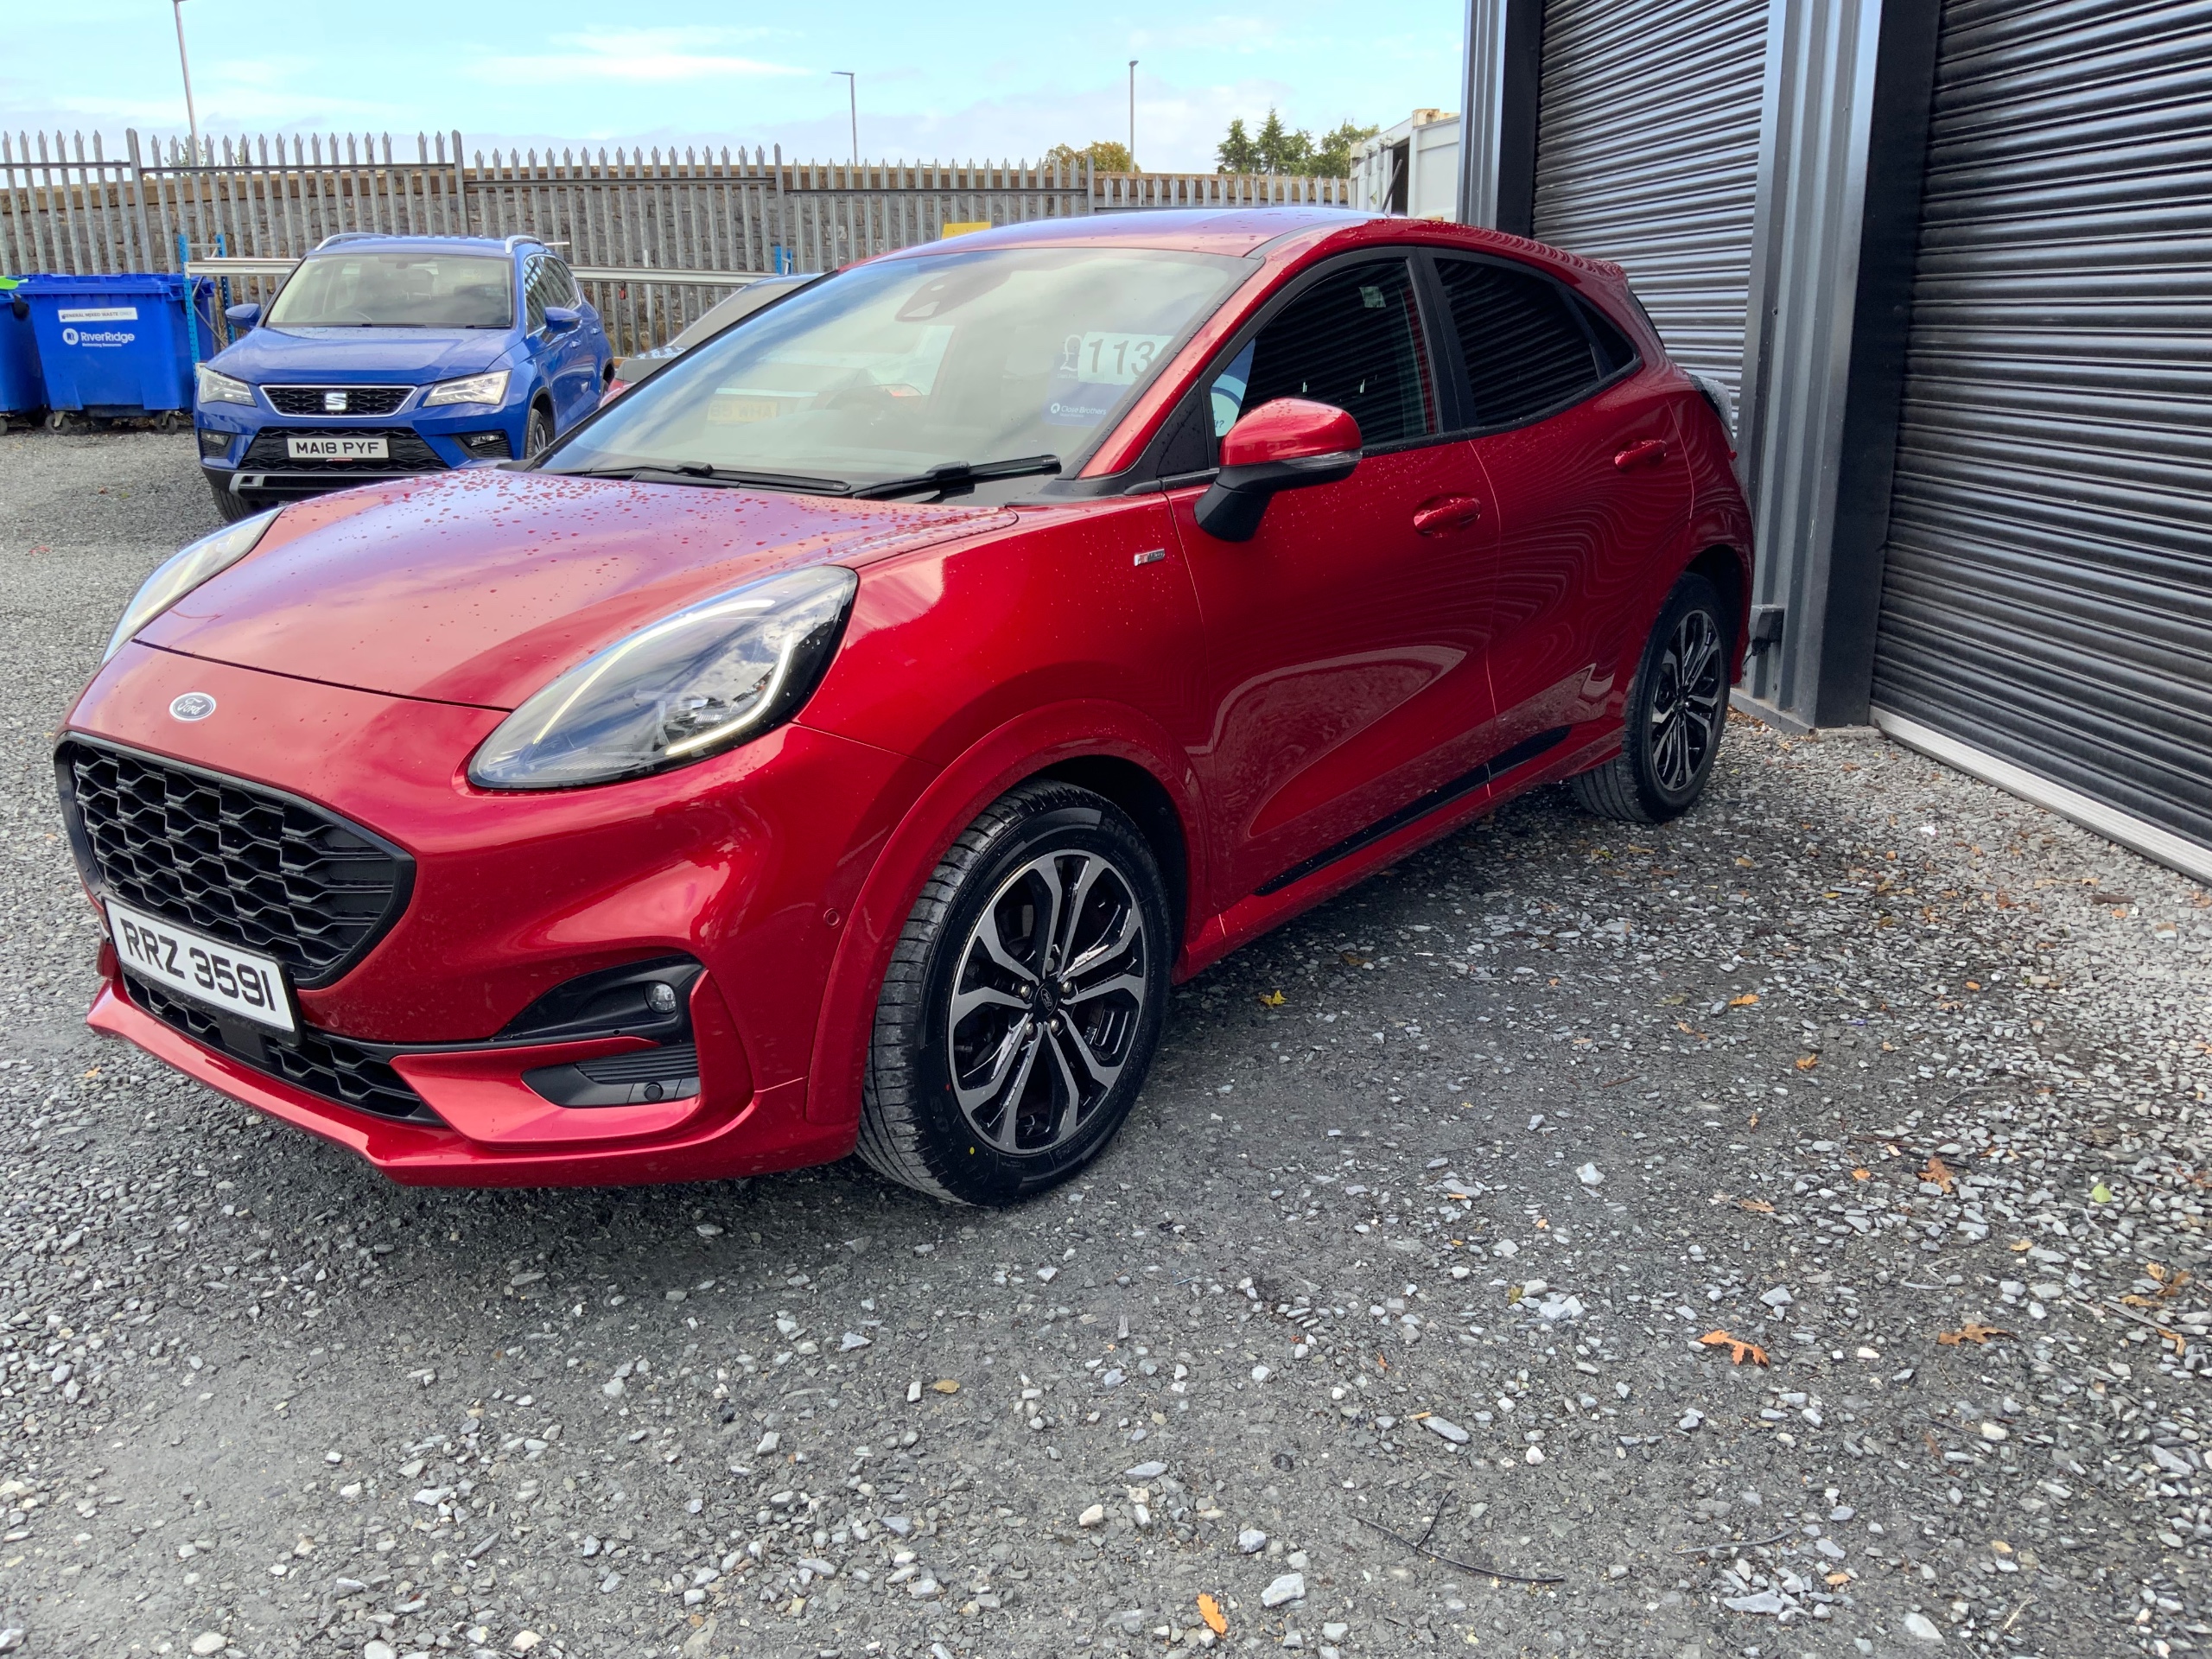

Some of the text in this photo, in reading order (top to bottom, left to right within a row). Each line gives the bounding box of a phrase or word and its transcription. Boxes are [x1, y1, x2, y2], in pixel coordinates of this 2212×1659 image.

[80, 331, 135, 344] RiverRidge
[1080, 406, 1107, 416] Brothers
[296, 442, 379, 454] MA18 PYF
[177, 697, 207, 715] Ford
[119, 917, 276, 1012] RRZ 3591
